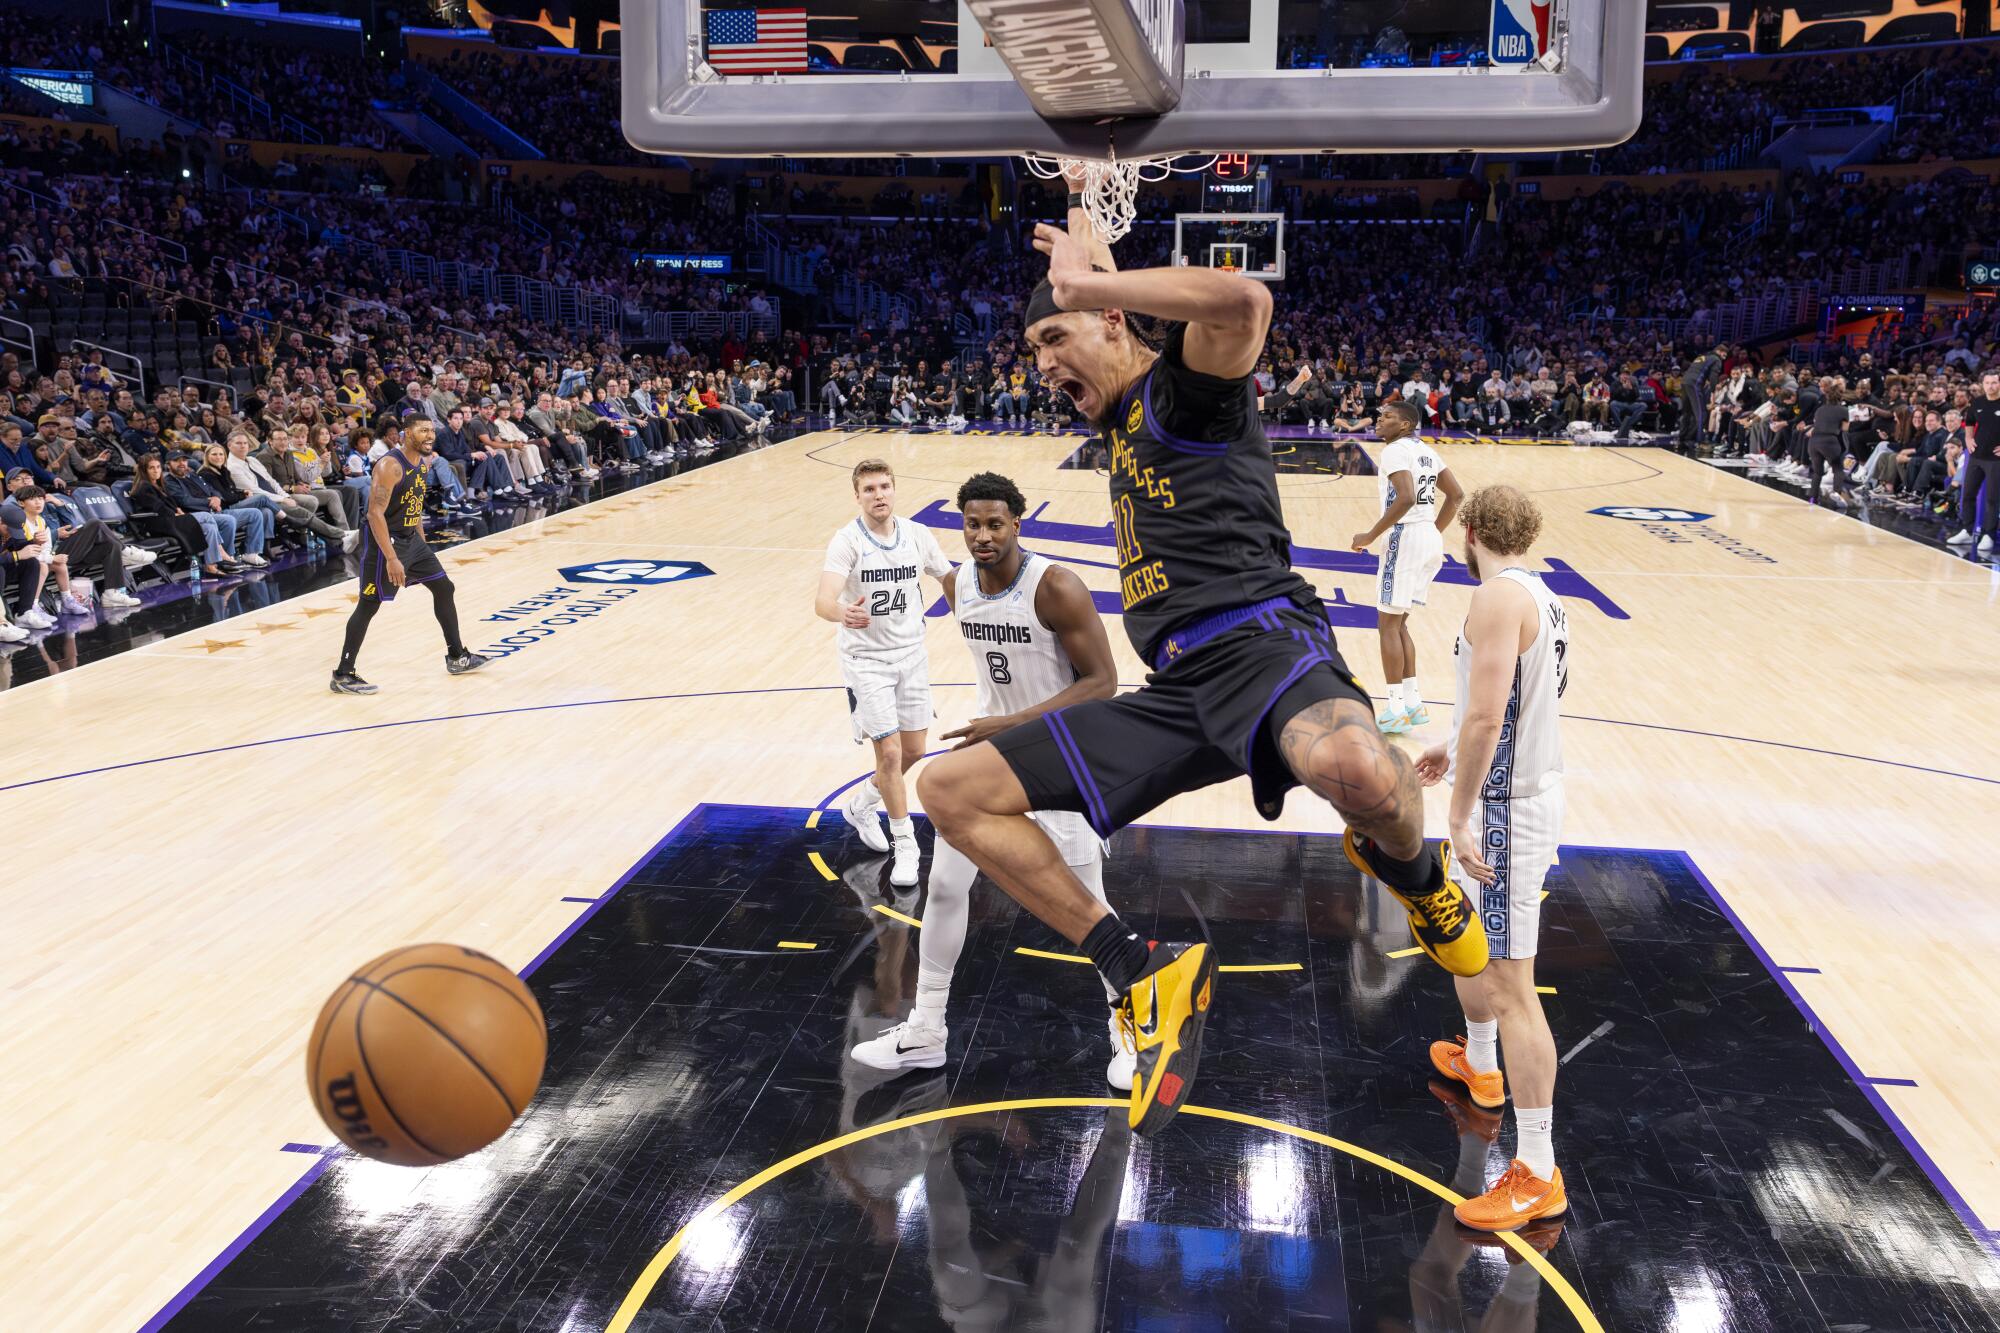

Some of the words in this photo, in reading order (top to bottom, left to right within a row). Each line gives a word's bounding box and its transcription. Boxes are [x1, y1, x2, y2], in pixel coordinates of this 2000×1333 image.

[1497, 34, 1527, 57] NBA
[1217, 153, 1248, 175] 24
[1221, 185, 1254, 193] TISSOT
[1846, 295, 1905, 305] CHAMPIONS
[91, 496, 118, 504] DELTA
[1416, 474, 1437, 505] 23
[1113, 494, 1143, 570] 11
[861, 565, 917, 584] memphis
[478, 586, 582, 622] ARENA
[871, 588, 907, 617] 24
[477, 588, 639, 659] crypto.com
[961, 620, 1032, 646] memphis
[986, 651, 1012, 685] 8
